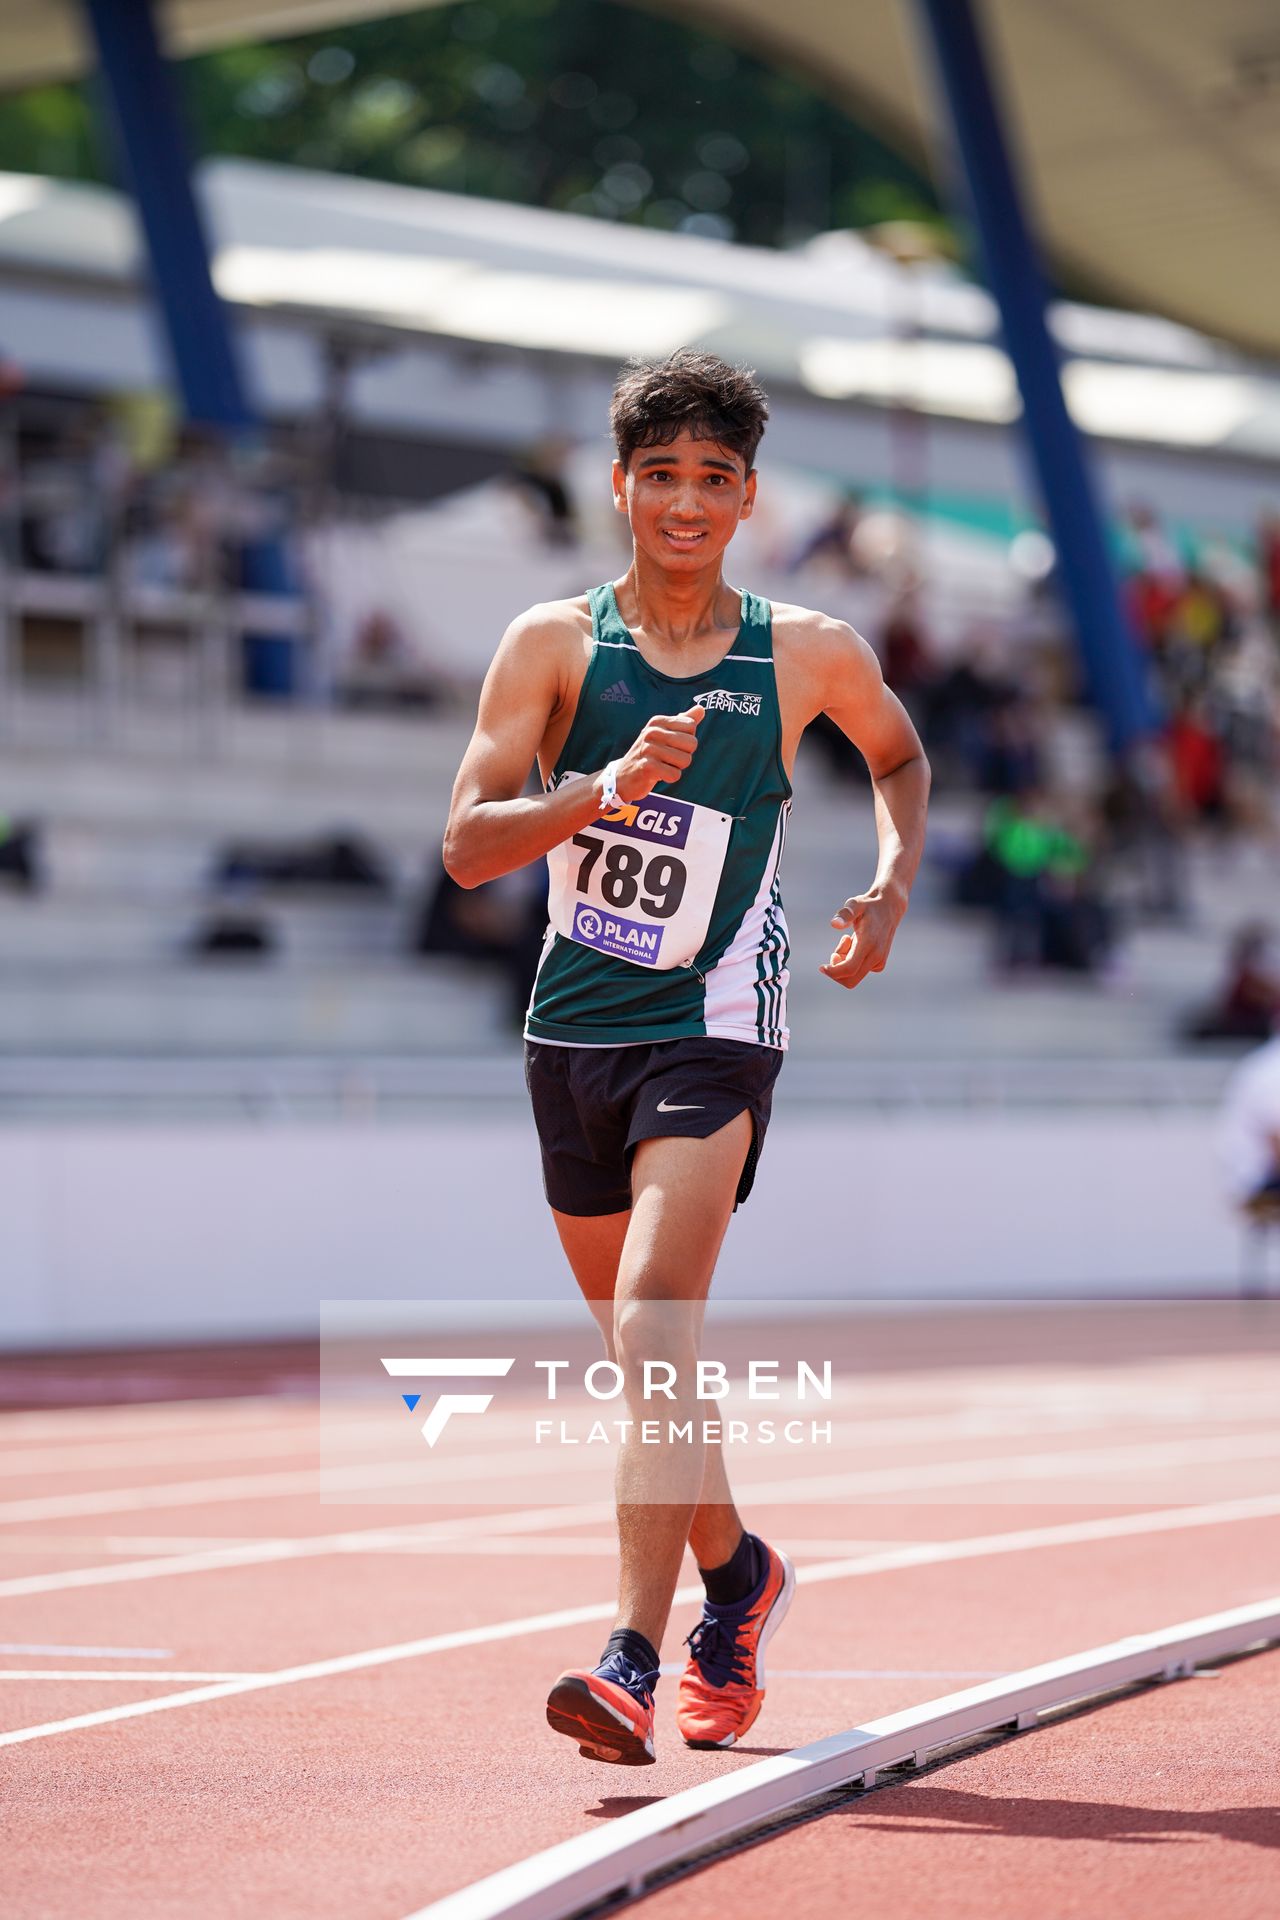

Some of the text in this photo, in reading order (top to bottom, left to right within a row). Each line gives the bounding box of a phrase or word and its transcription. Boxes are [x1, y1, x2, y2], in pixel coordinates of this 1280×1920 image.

[600, 692, 635, 704] adidas
[697, 696, 761, 716] CIERPINSKI
[743, 694, 763, 703] SPORT
[636, 810, 681, 837] GLS
[572, 833, 687, 919] 789
[604, 920, 657, 950] PLAN
[602, 939, 653, 959] INTERNATIONAL
